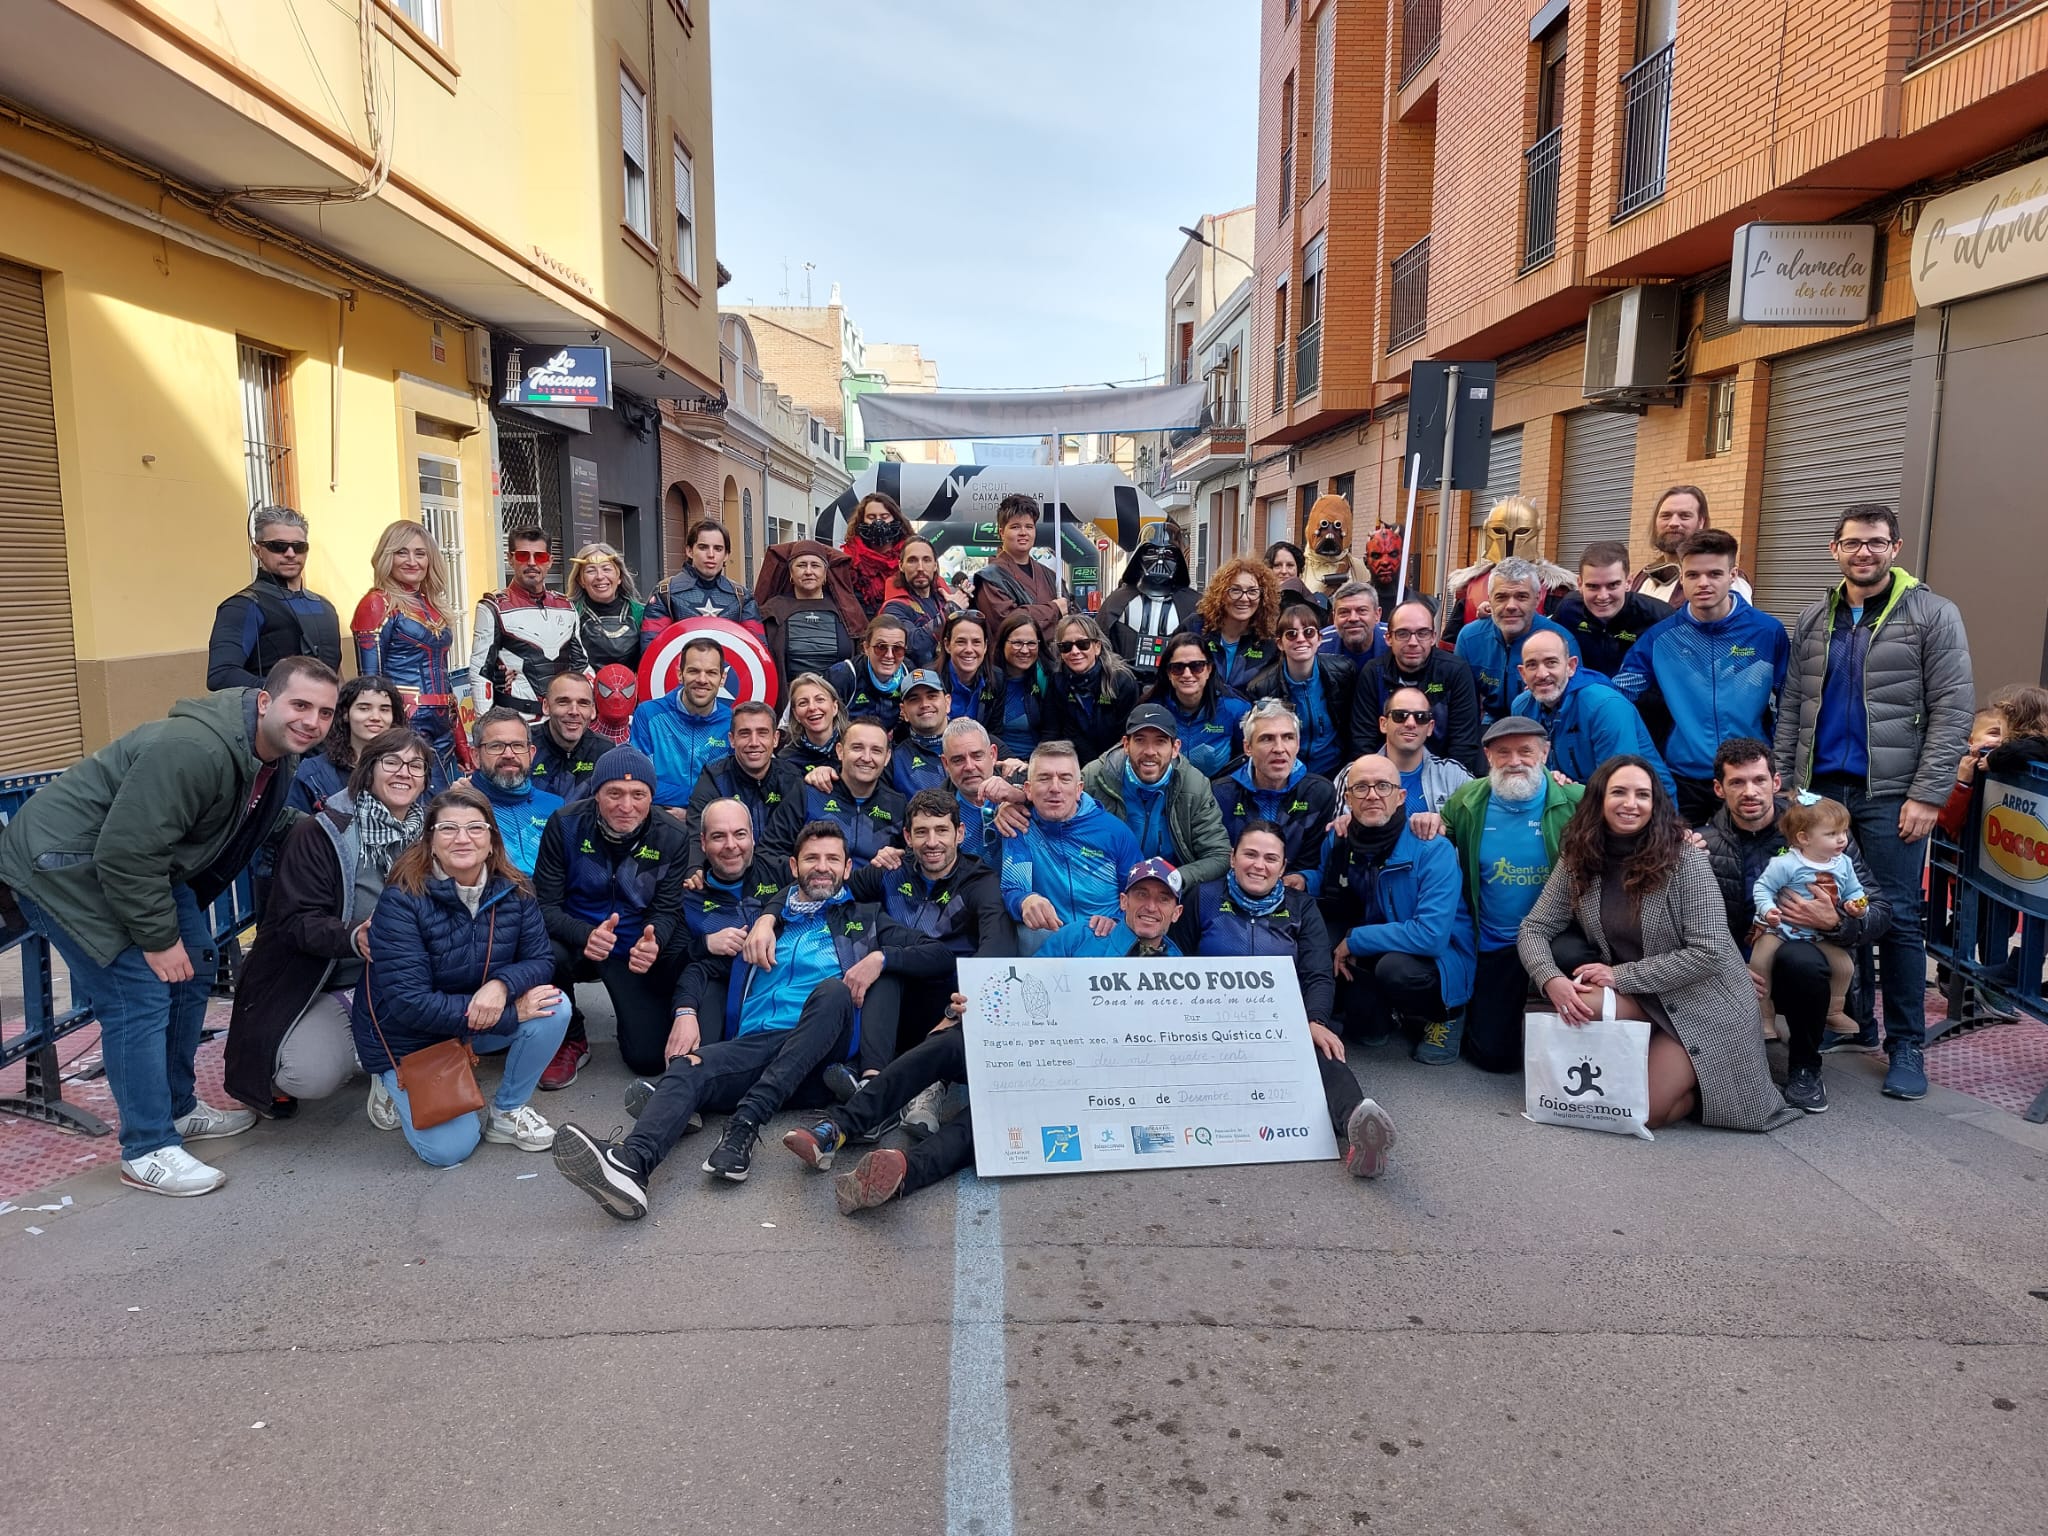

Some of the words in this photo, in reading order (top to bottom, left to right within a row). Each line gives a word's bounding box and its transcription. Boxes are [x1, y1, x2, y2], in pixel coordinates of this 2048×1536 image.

[1777, 248, 1867, 280] alameda
[1795, 282, 1818, 299] des
[1820, 282, 1835, 297] de
[1839, 284, 1865, 298] 1992
[547, 351, 576, 376] La
[528, 367, 597, 389] Toscana
[538, 387, 590, 395] PIZZERIA
[971, 482, 1008, 491] CIRCUIT
[972, 492, 999, 501] CAIXA
[2002, 793, 2037, 816] ARROZ
[1988, 814, 2048, 866] Dacsa
[1508, 866, 1534, 874] Gent
[1537, 865, 1550, 874] de
[1508, 874, 1551, 886] FOIOS
[1053, 974, 1071, 992] XI
[1088, 972, 1132, 992] 10K
[1137, 971, 1201, 991] ARCO
[1205, 971, 1275, 990] FOIOS
[1092, 994, 1145, 1006] Dona'm
[1191, 994, 1239, 1005] dona'm
[1246, 994, 1275, 1004] vida
[1184, 1014, 1201, 1022] Eur
[1028, 1039, 1045, 1047] per
[1050, 1037, 1085, 1047] aquest
[1124, 1033, 1156, 1043] Asoc.
[1160, 1031, 1208, 1042] Fibrosis
[1212, 1029, 1262, 1044] Quística
[1265, 1029, 1288, 1040] C.V.
[985, 1060, 1014, 1068] Euros
[1017, 1059, 1032, 1067] (en
[1036, 1058, 1076, 1067] lletres)
[1088, 1095, 1125, 1107] Foios,
[1128, 1097, 1136, 1105] a
[1156, 1093, 1171, 1104] de
[1251, 1090, 1265, 1100] de
[1539, 1095, 1633, 1118] foiosesmou
[1184, 1127, 1212, 1146] FQ
[1277, 1126, 1308, 1138] arco
